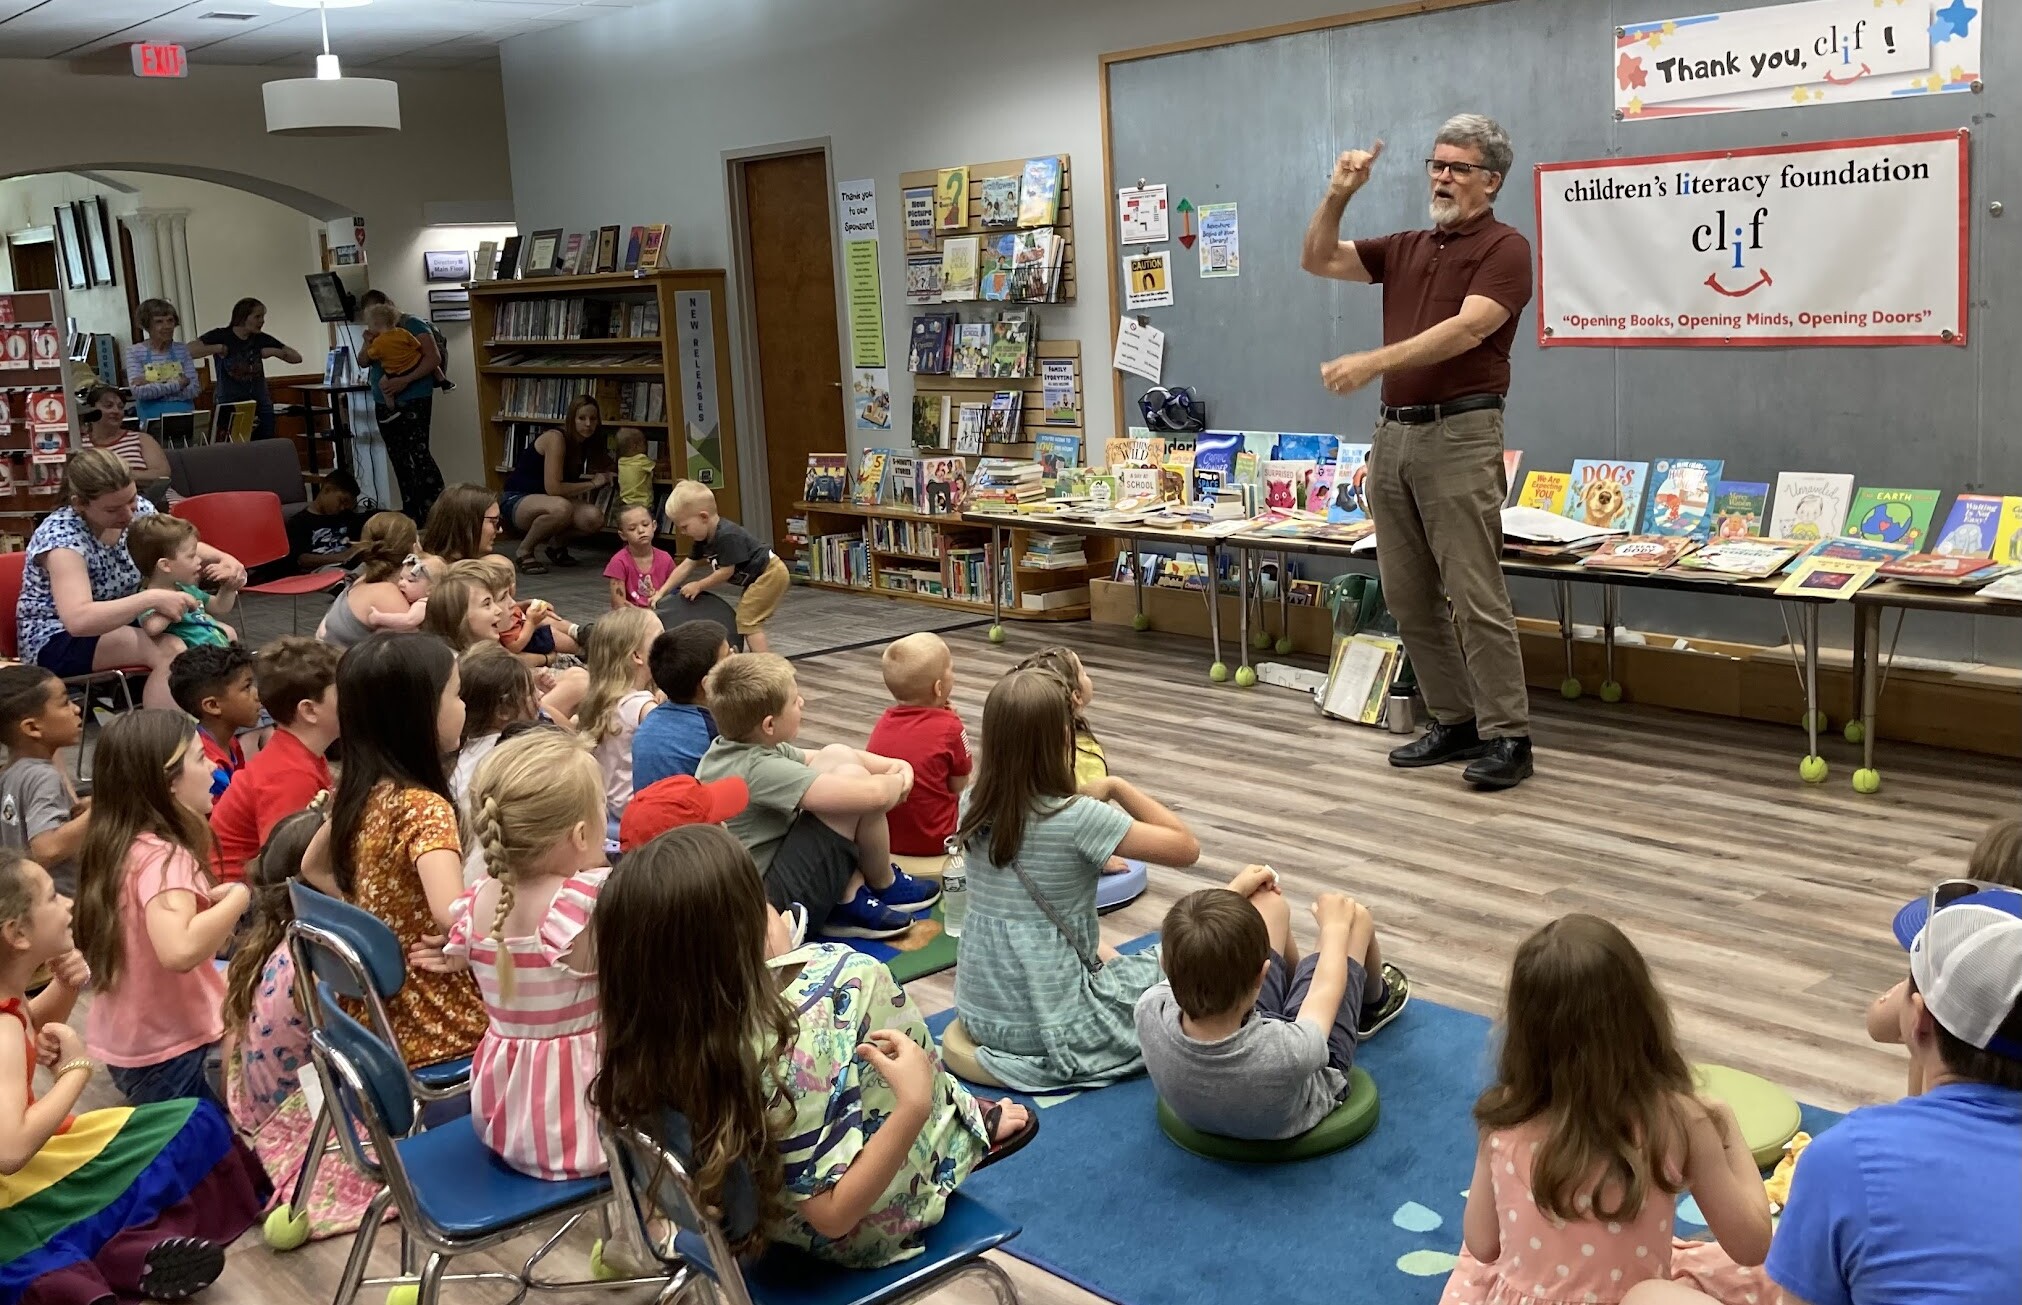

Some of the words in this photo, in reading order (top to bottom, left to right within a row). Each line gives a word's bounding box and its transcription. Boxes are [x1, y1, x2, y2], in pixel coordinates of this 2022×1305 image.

[1656, 52, 1741, 84] Thank
[1751, 46, 1807, 79] you,
[1814, 20, 1866, 65] clif
[141, 46, 179, 76] EXIT
[1564, 174, 1667, 202] children's
[1675, 170, 1770, 198] literacy
[1780, 157, 1930, 189] foundation
[841, 192, 861, 201] Thank
[862, 190, 873, 201] you
[849, 206, 856, 216] to
[857, 207, 868, 215] our
[844, 220, 875, 234] Sponsors!
[1692, 207, 1768, 268] clif
[1132, 259, 1162, 270] CAUTION
[689, 297, 699, 330] NEW
[1562, 314, 1626, 331] "Opening
[1630, 313, 1674, 330] Books,
[1677, 312, 1742, 329] Opening
[1746, 311, 1793, 328] Minds,
[1799, 310, 1870, 328] Opening
[1873, 309, 1932, 324] Doors"
[693, 338, 705, 422] RELEASES
[874, 456, 882, 468] 5
[1264, 469, 1294, 478] SURPRISED
[1537, 474, 1548, 483] We
[1549, 476, 1560, 484] Are
[1582, 463, 1636, 486] DOGS
[1126, 481, 1154, 490] SCHOOL
[1198, 479, 1219, 488] SPACE
[1531, 481, 1562, 492] Expecting
[1535, 489, 1554, 499] YOU!
[1785, 482, 1840, 498] Unraveled
[1876, 492, 1912, 501] EARTH
[1966, 502, 1998, 512] Waiting
